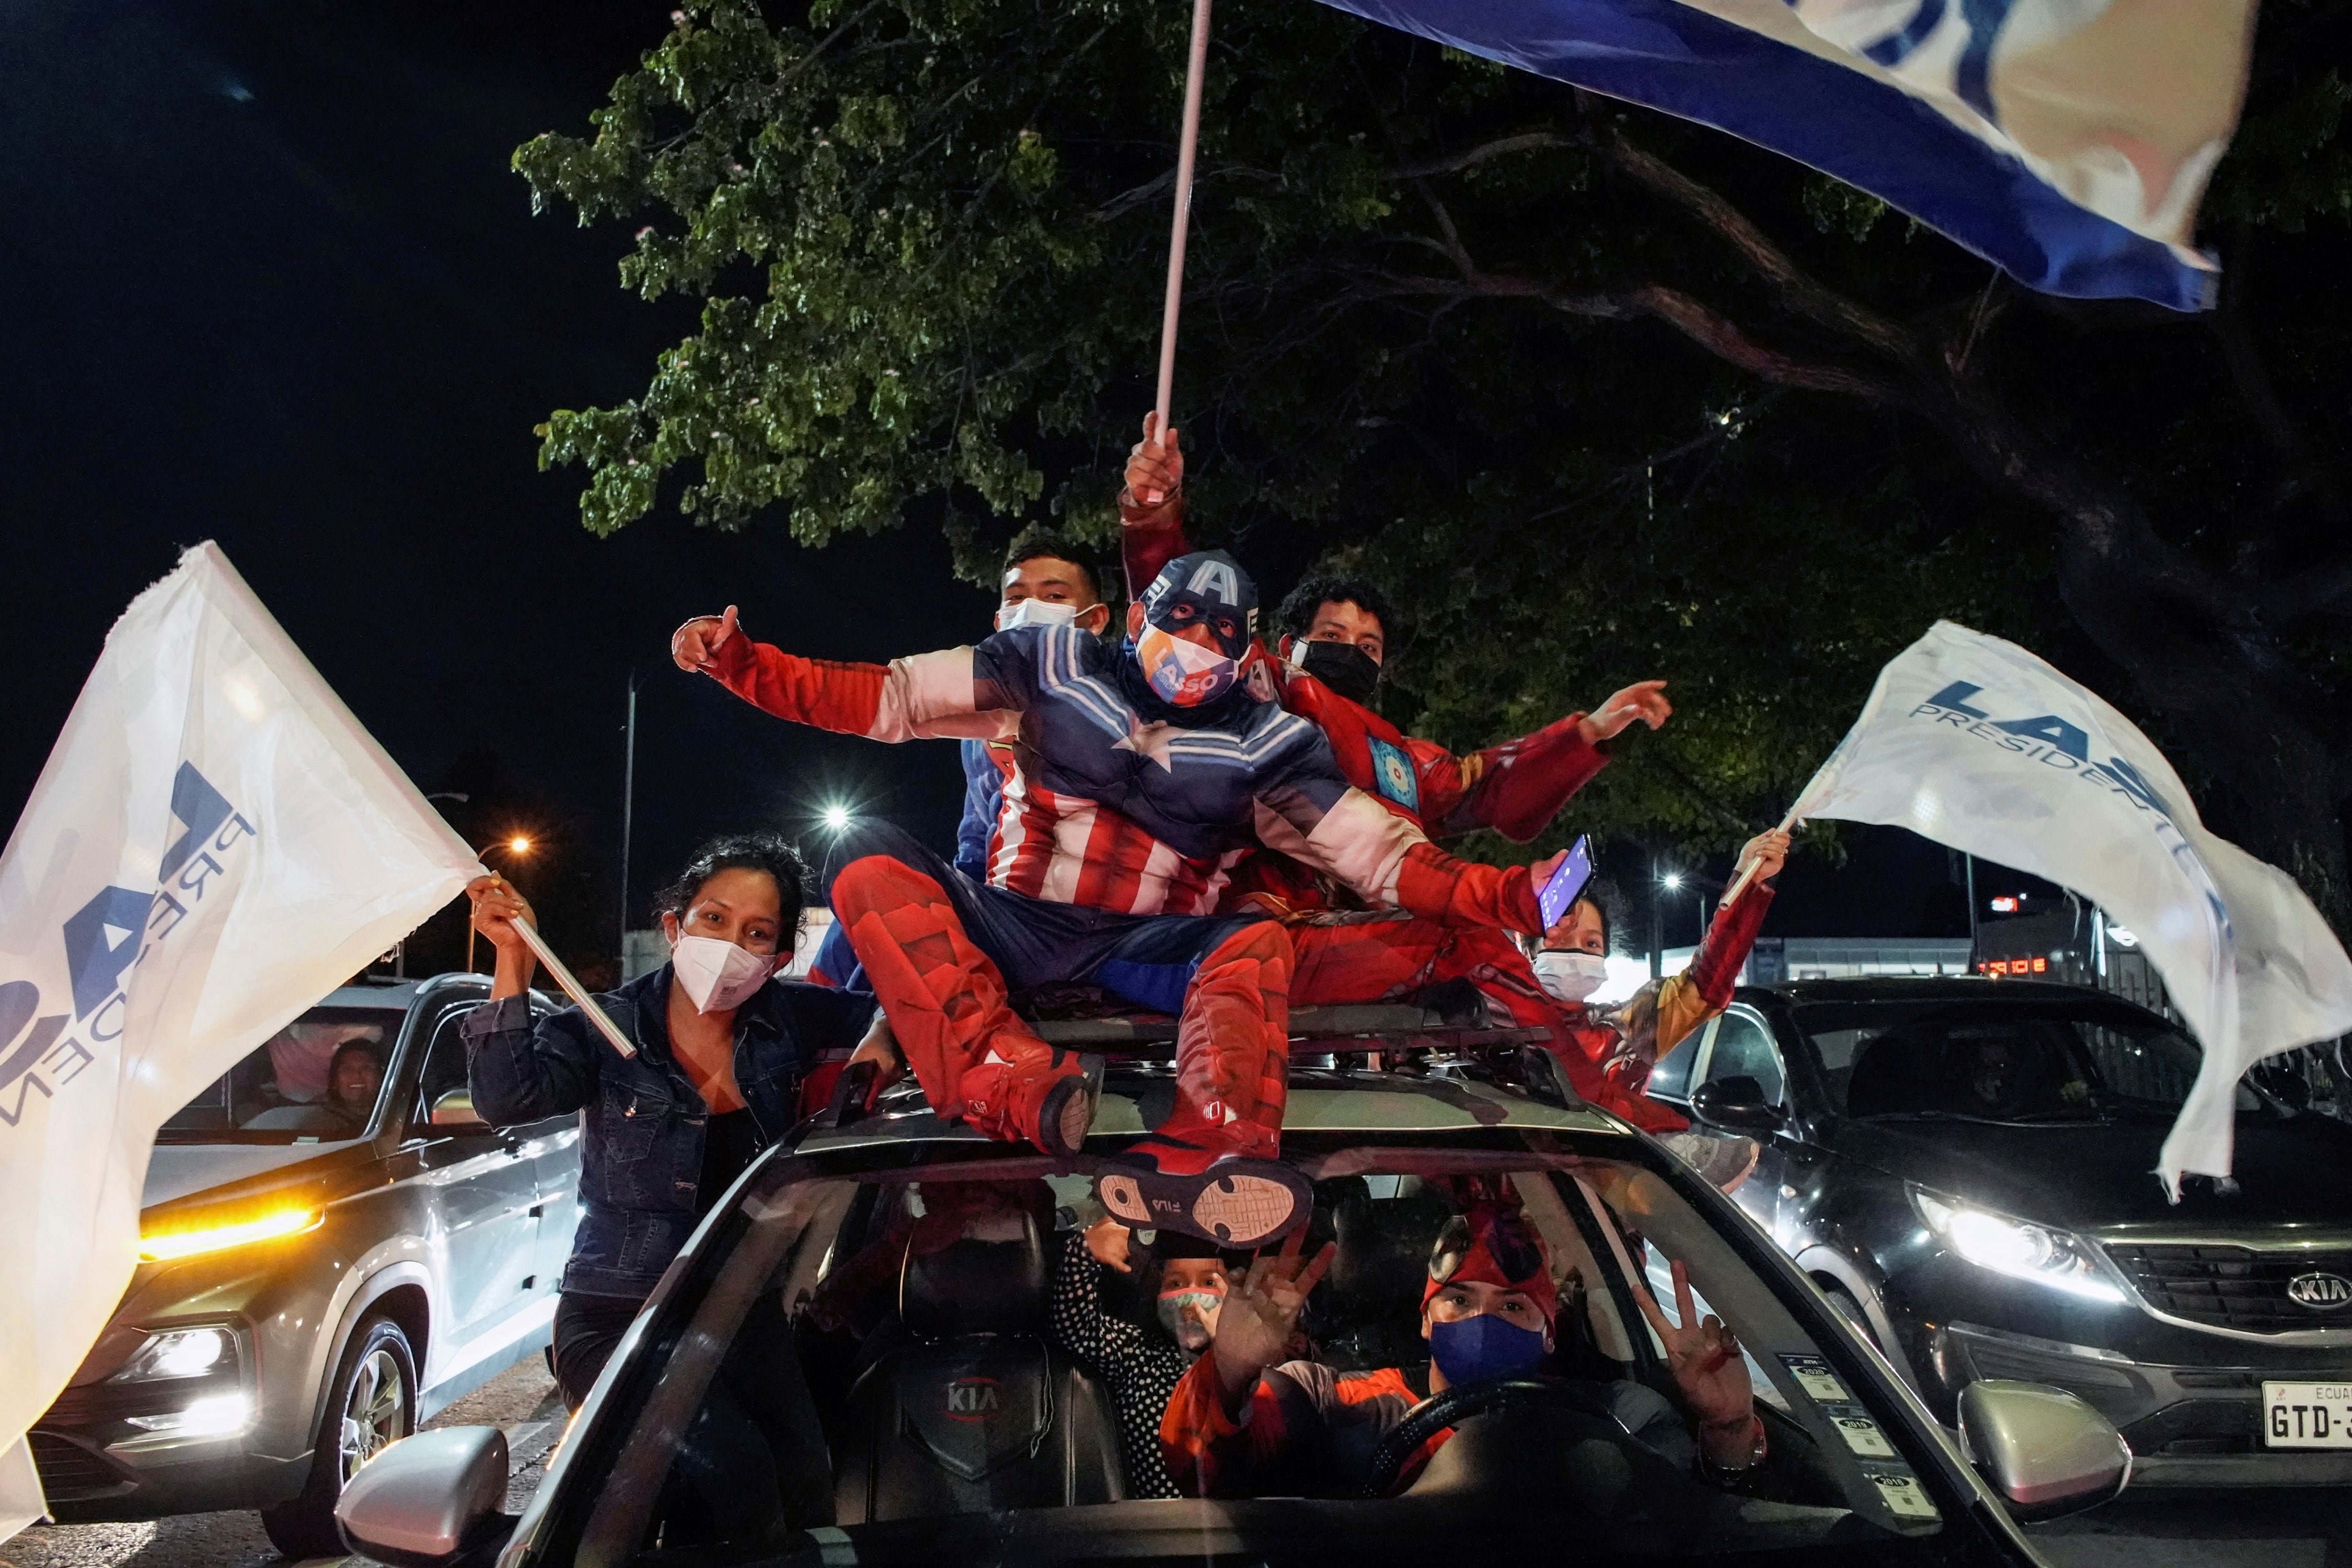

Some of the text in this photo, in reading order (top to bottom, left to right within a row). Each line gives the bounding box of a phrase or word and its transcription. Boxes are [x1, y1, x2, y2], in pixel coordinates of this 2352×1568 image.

[1185, 560, 1238, 606] A
[1154, 648, 1218, 693] LASSO
[1152, 1199, 1182, 1212] FILA
[2299, 1279, 2348, 1300] KIA
[948, 1384, 998, 1411] KIA
[2316, 1387, 2352, 1400] ECUA
[1880, 1478, 1905, 1486] 2018
